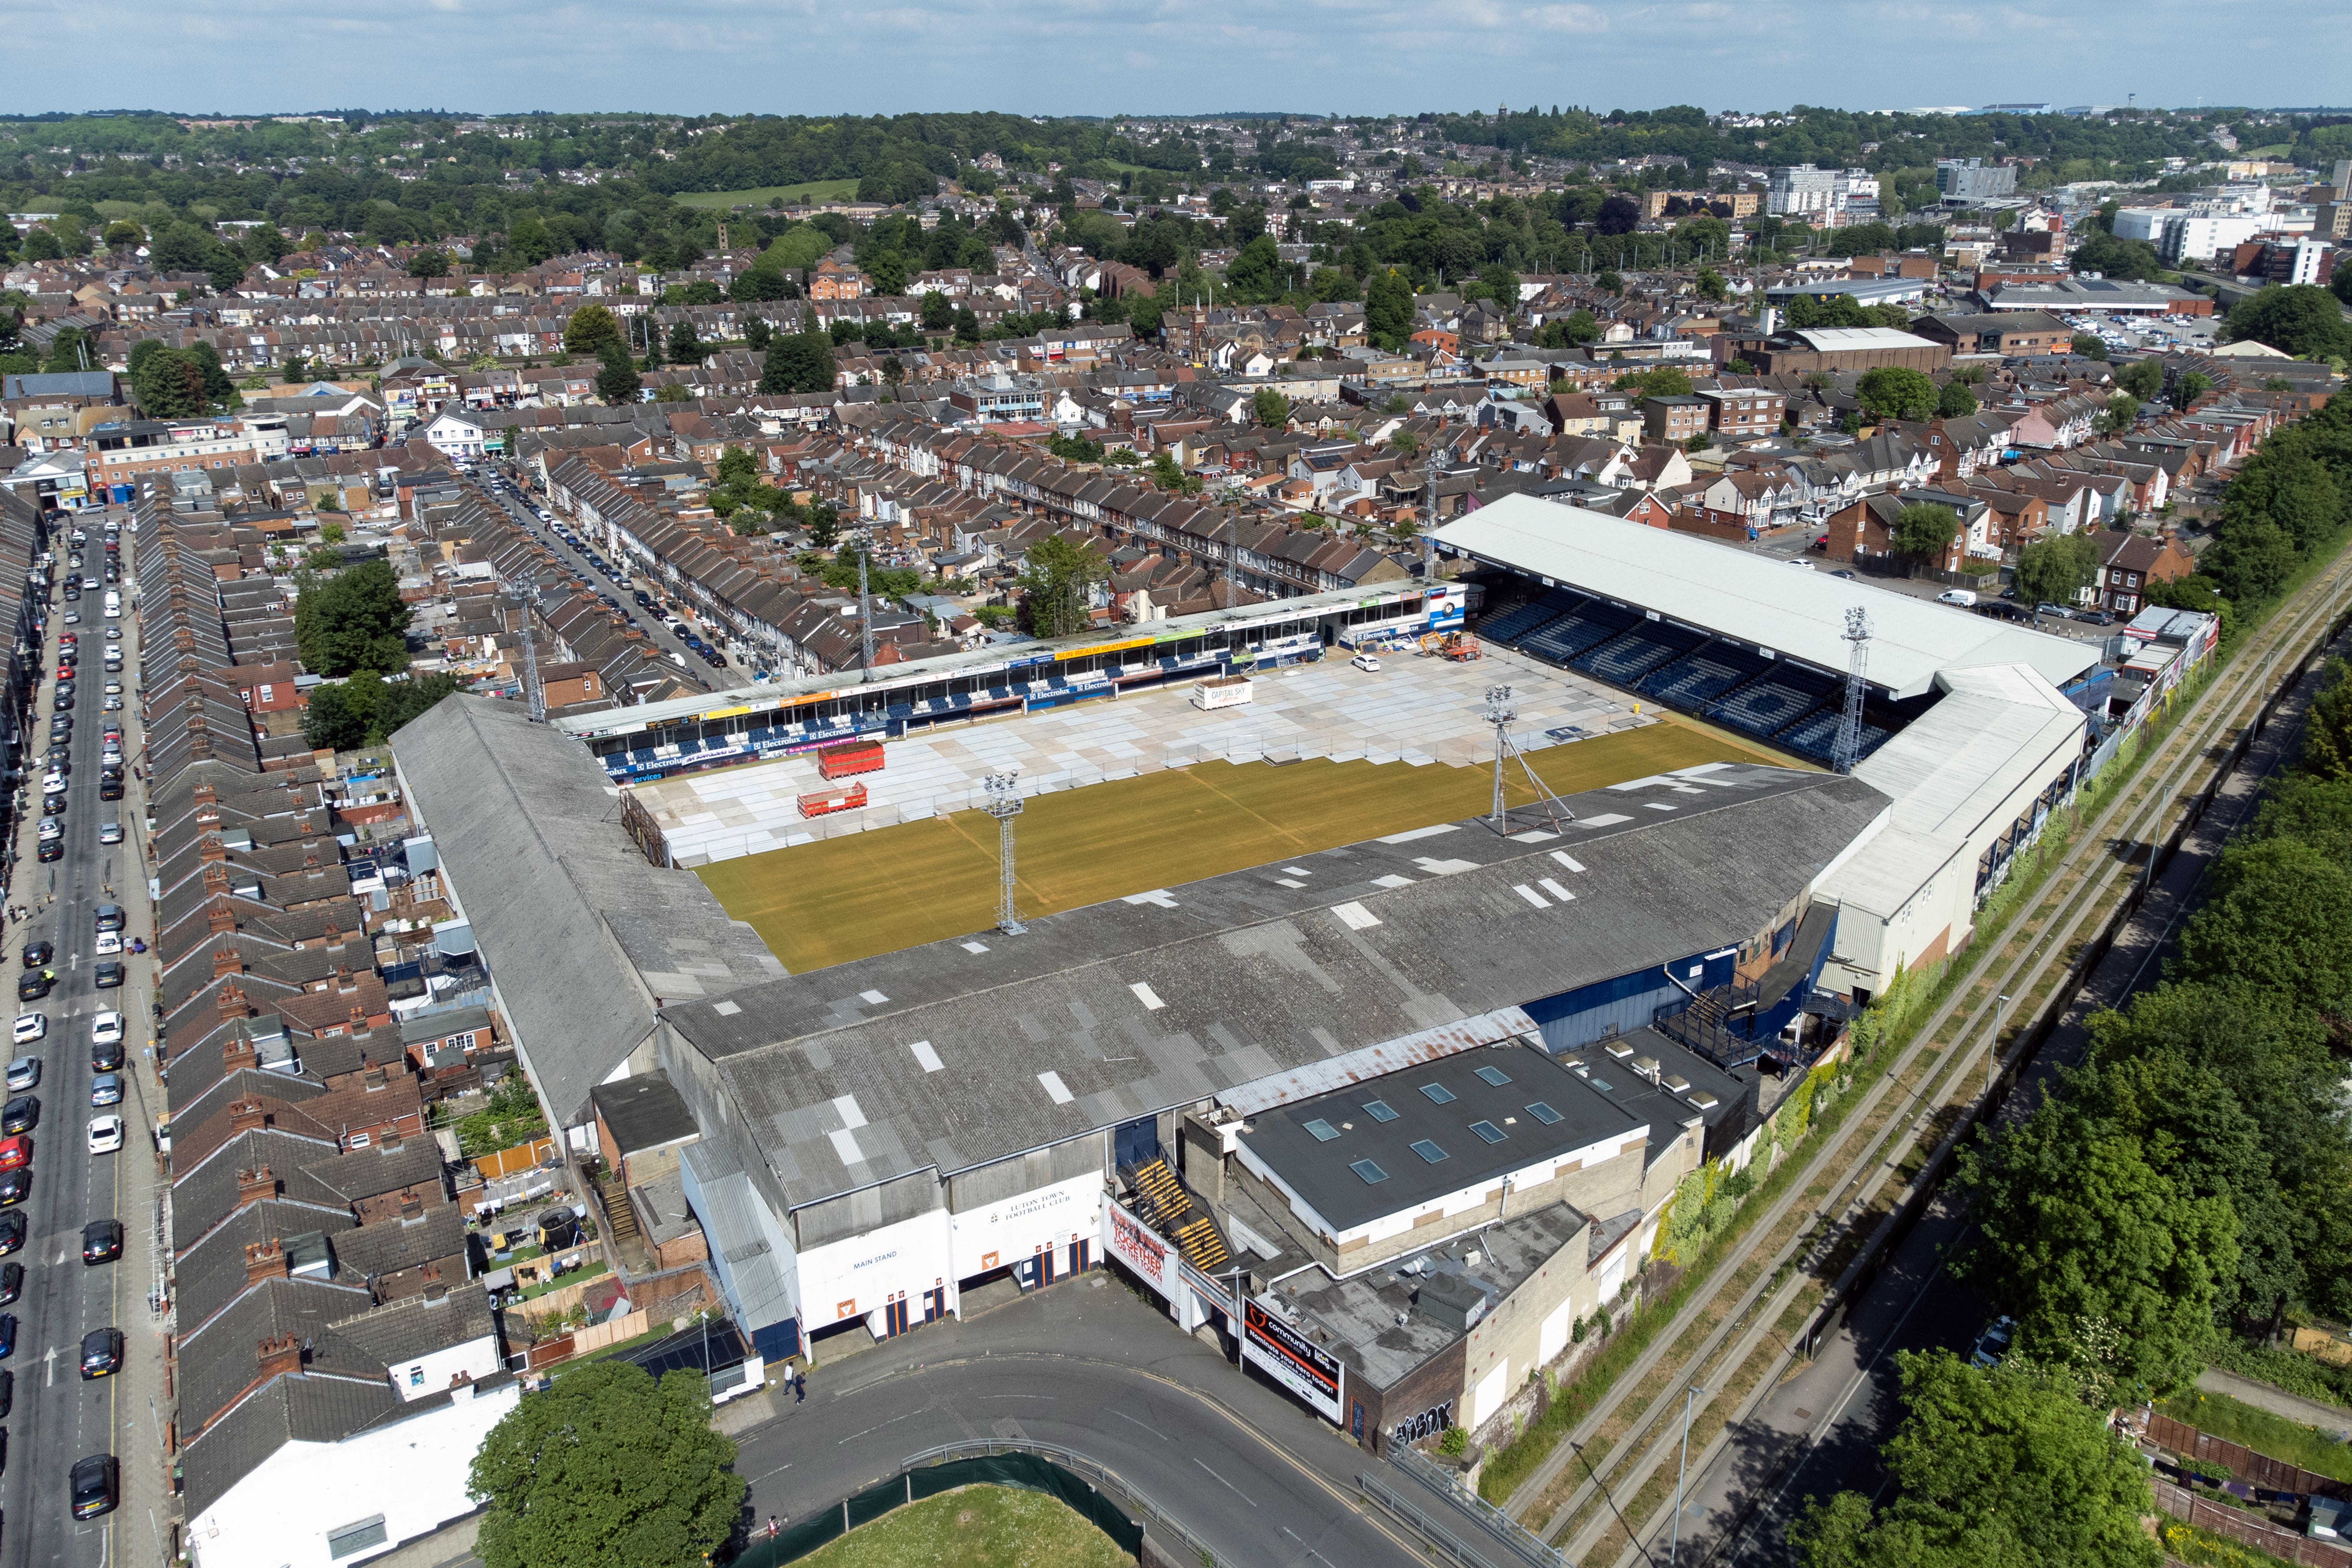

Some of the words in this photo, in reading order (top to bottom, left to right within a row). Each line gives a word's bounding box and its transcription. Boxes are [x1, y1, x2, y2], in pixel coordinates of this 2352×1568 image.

[1363, 630, 1390, 640] Electrolux
[1075, 647, 1100, 657] REALM
[1102, 642, 1131, 652] HEATING
[866, 683, 893, 691] Tradeline
[894, 678, 925, 687] Recruitment
[1085, 680, 1112, 690] Electrolu
[1038, 688, 1070, 699] Electrolux
[1212, 689, 1234, 699] CAPITAL
[1235, 687, 1245, 695] SKY
[818, 727, 855, 738] Electrolux
[763, 737, 800, 748] Electrolux
[646, 758, 682, 769] Electrolu
[1011, 1199, 1038, 1211] LUTON
[1040, 1190, 1065, 1202] TOWN
[1006, 1205, 1047, 1220] FOOTBALL
[1050, 1196, 1070, 1206] CLUB
[1114, 1225, 1161, 1274] TOGETHER
[853, 1259, 873, 1269] MAIN
[875, 1251, 897, 1263] STAND
[1114, 1238, 1127, 1254] FOR
[1128, 1247, 1139, 1263] THE
[1141, 1258, 1162, 1282] TOWN
[840, 1299, 853, 1308] GATE
[1269, 1322, 1311, 1357] community
[1277, 1335, 1293, 1348] AWARDS
[1250, 1329, 1279, 1355] Nominate
[1280, 1351, 1295, 1368] your
[1296, 1363, 1311, 1378] hero
[1312, 1372, 1333, 1394] today!
[1315, 1349, 1328, 1362] Luton
[1314, 1355, 1330, 1370] Rising
